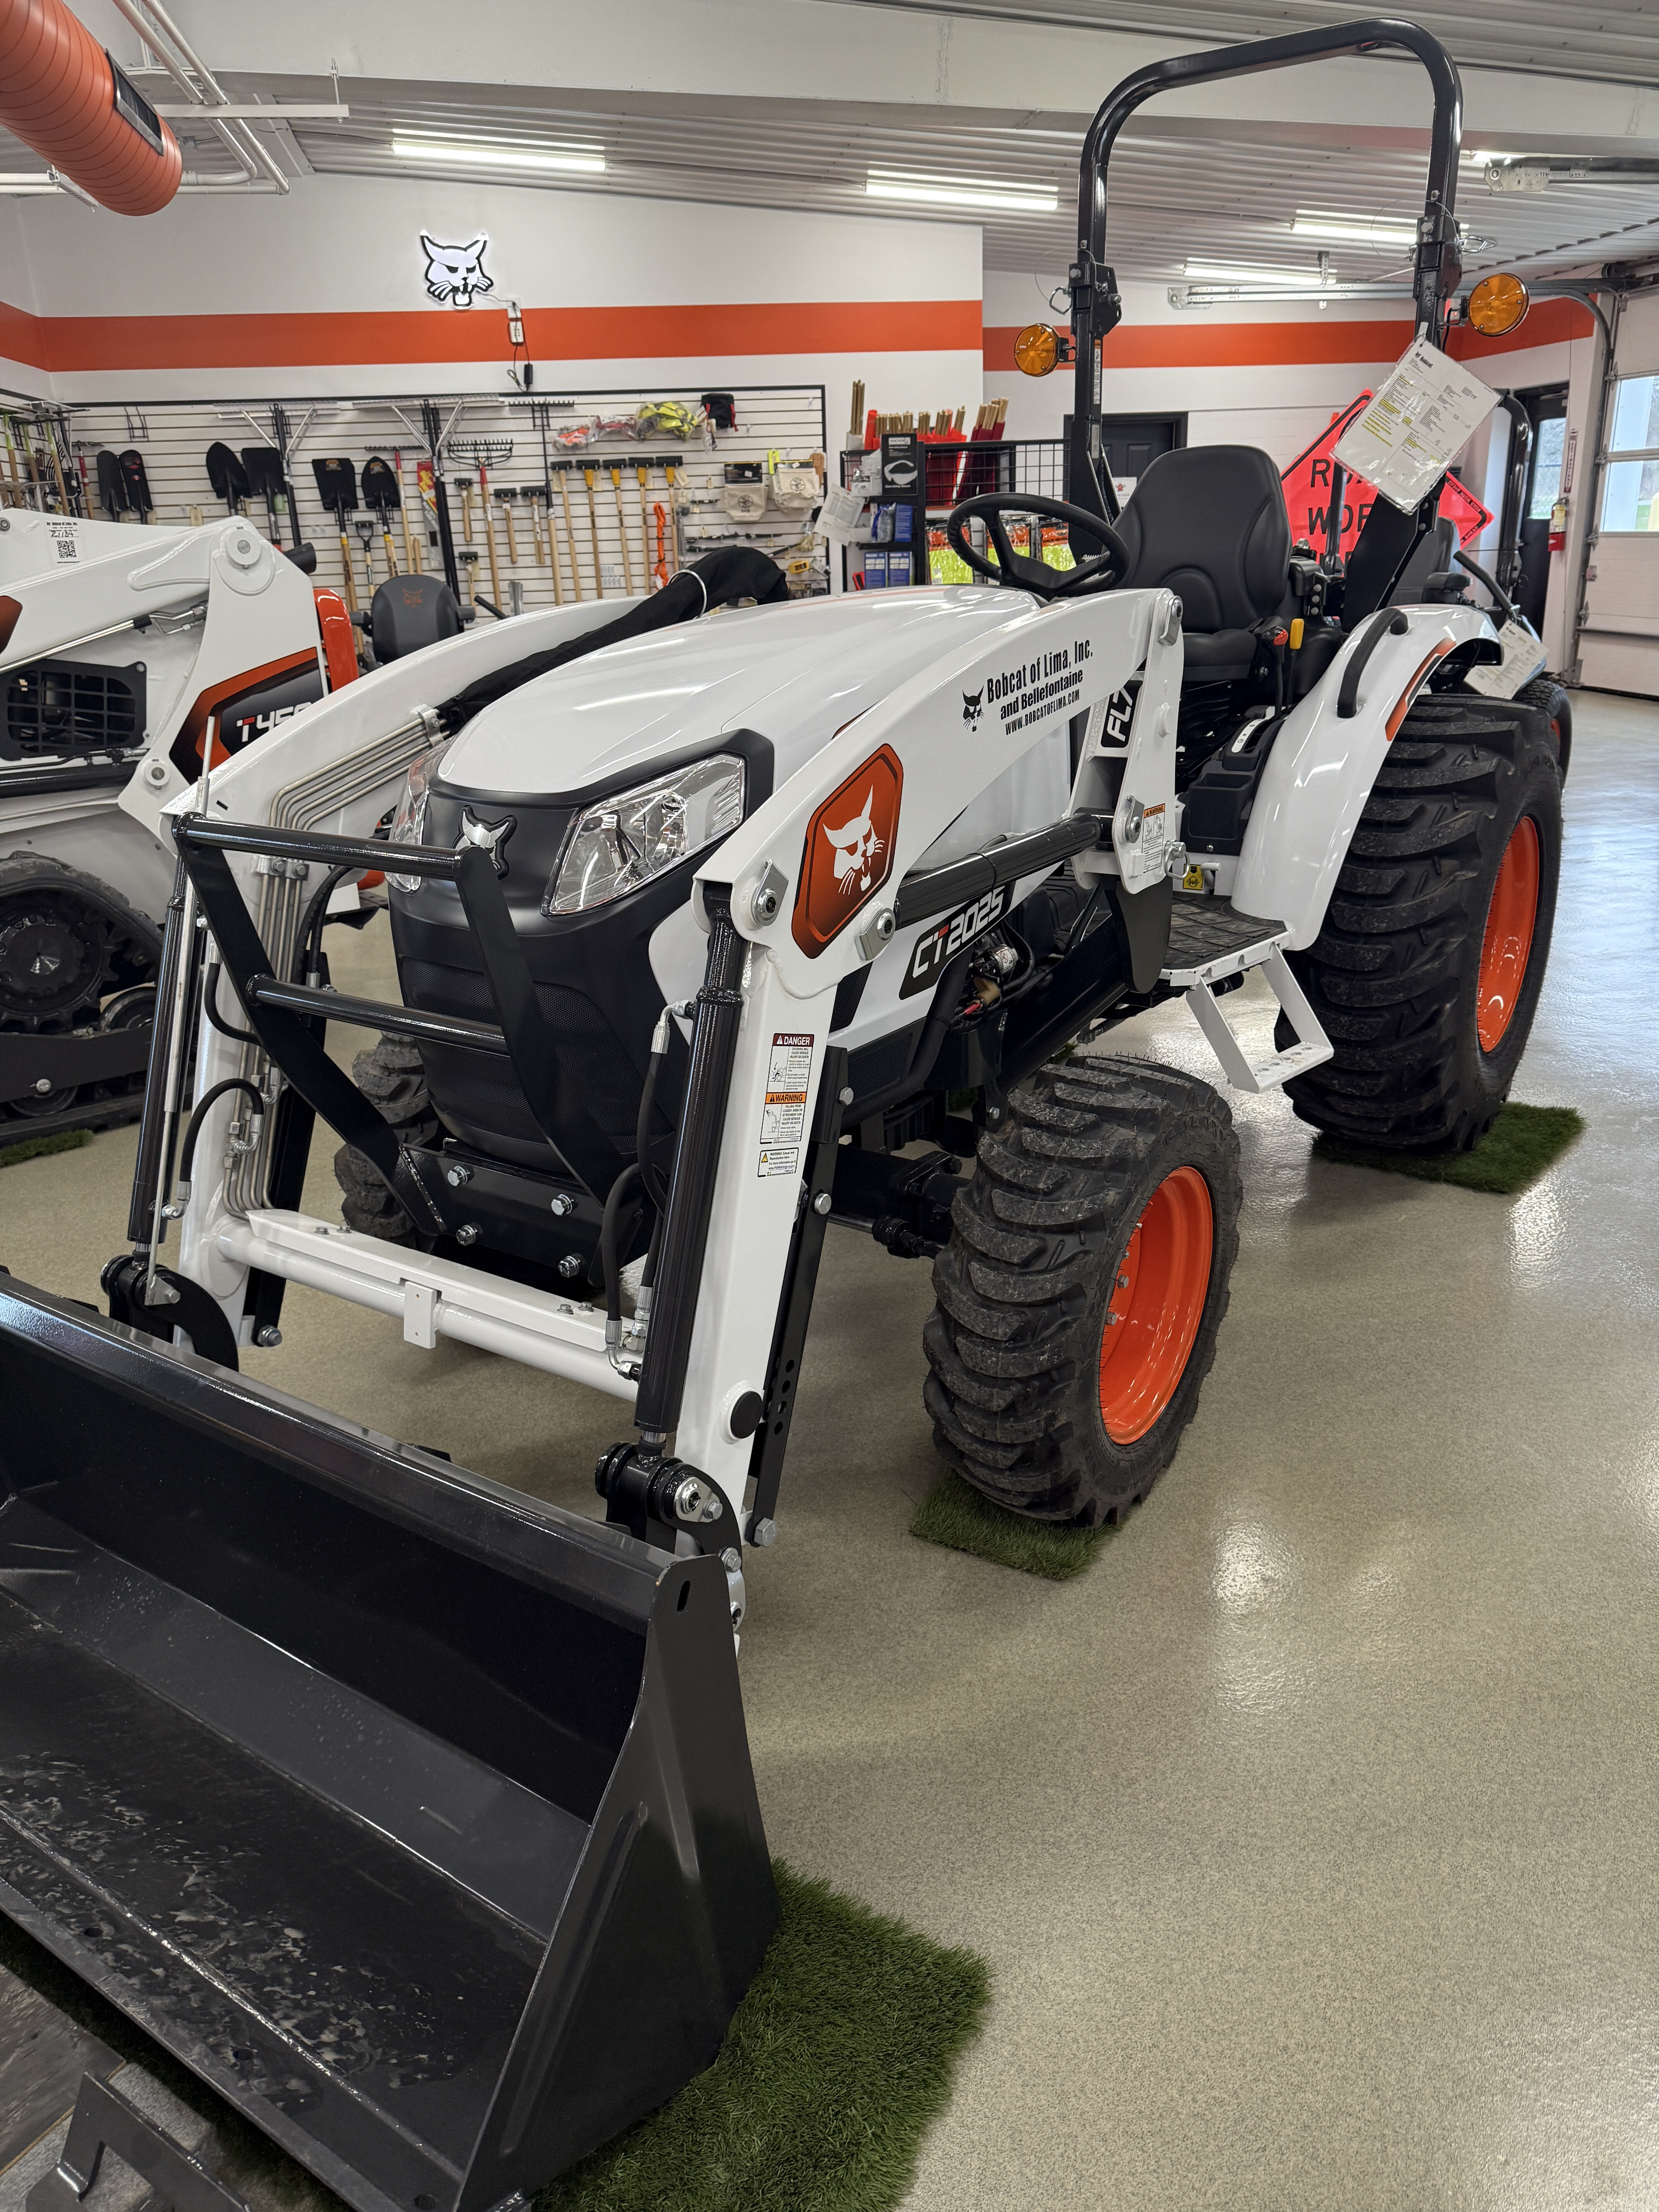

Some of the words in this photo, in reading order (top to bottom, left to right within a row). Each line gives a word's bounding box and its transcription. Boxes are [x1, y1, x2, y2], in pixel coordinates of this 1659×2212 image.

[987, 665, 1027, 704] Bobcat
[1030, 657, 1040, 684] of
[1044, 649, 1071, 678] Lima,
[1075, 639, 1093, 664] Inc.
[1001, 696, 1019, 720] and
[1021, 670, 1083, 710] Bellefontaine
[1005, 689, 1080, 735] WWW.BOBCATOFLIMA.COM
[784, 1036, 810, 1045] DANGER
